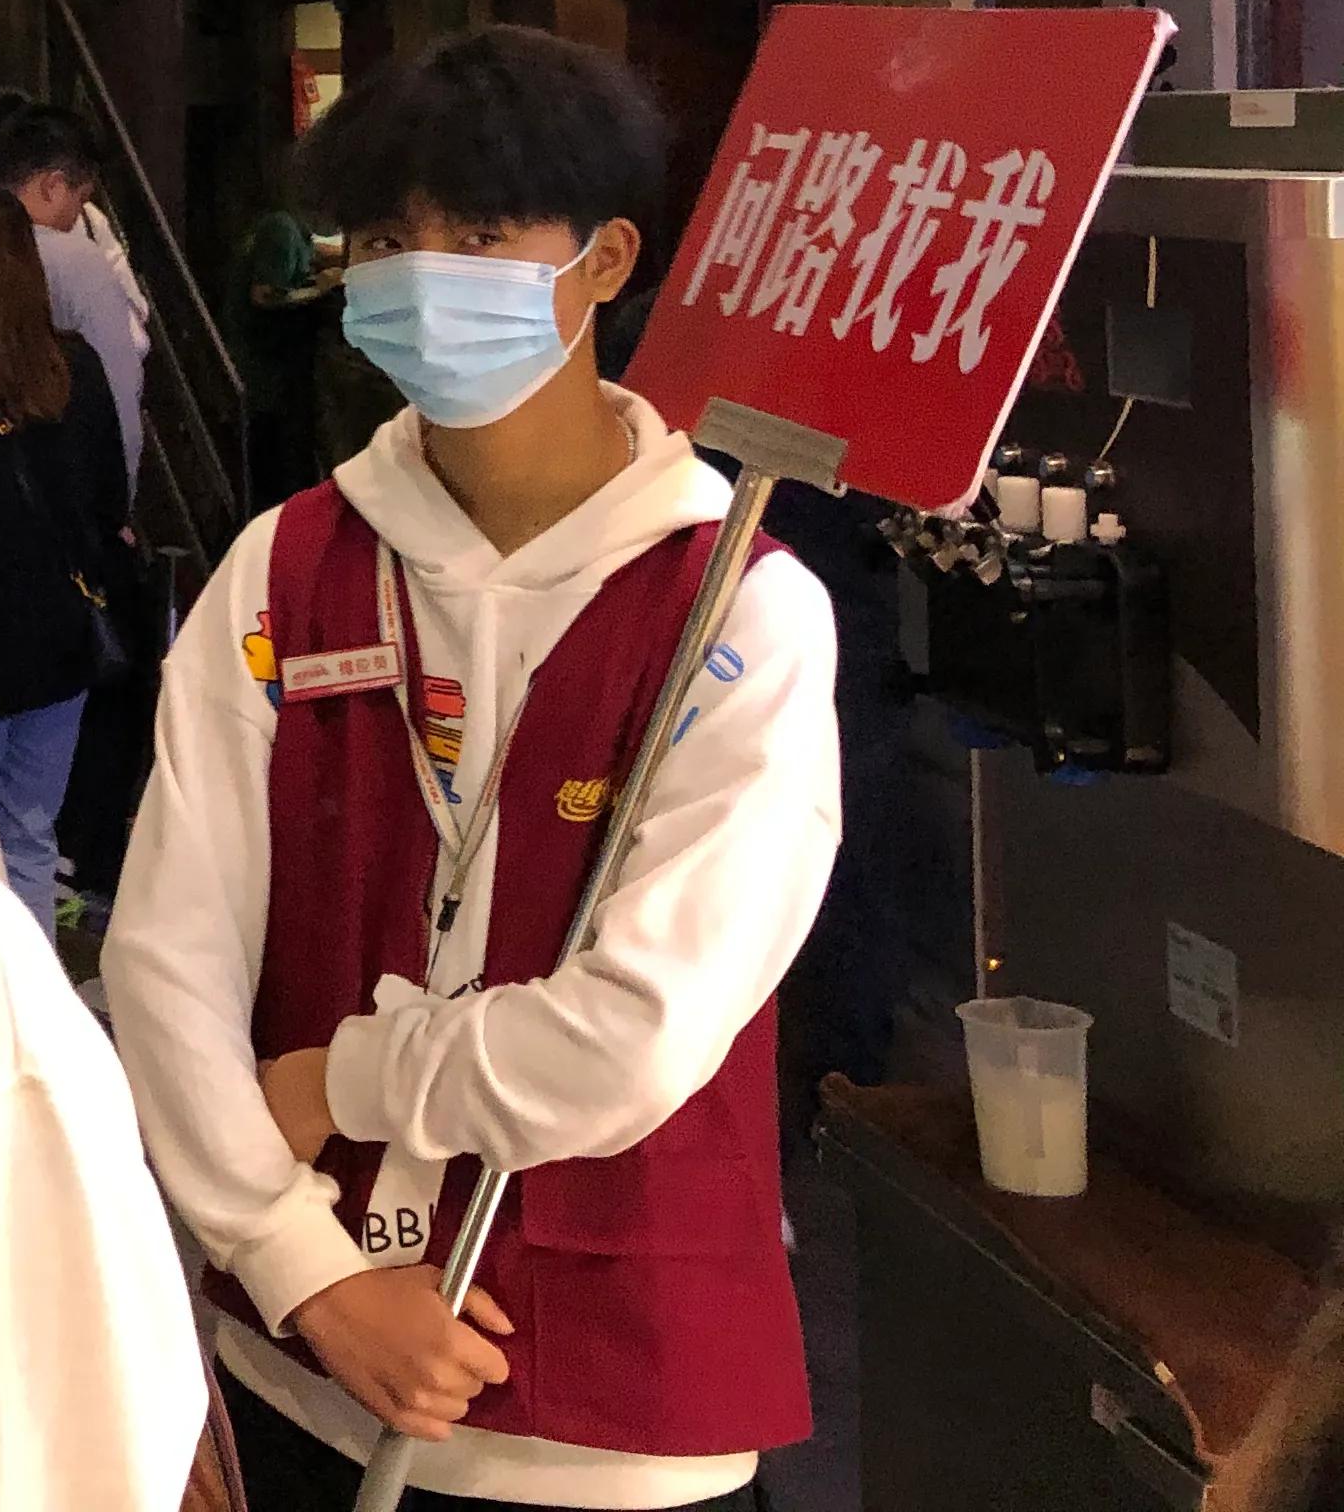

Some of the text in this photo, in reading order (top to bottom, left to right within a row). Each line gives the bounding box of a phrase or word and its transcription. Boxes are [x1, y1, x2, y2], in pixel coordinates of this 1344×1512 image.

[681, 122, 1056, 375] 问路找我
[365, 1202, 437, 1254] BB
